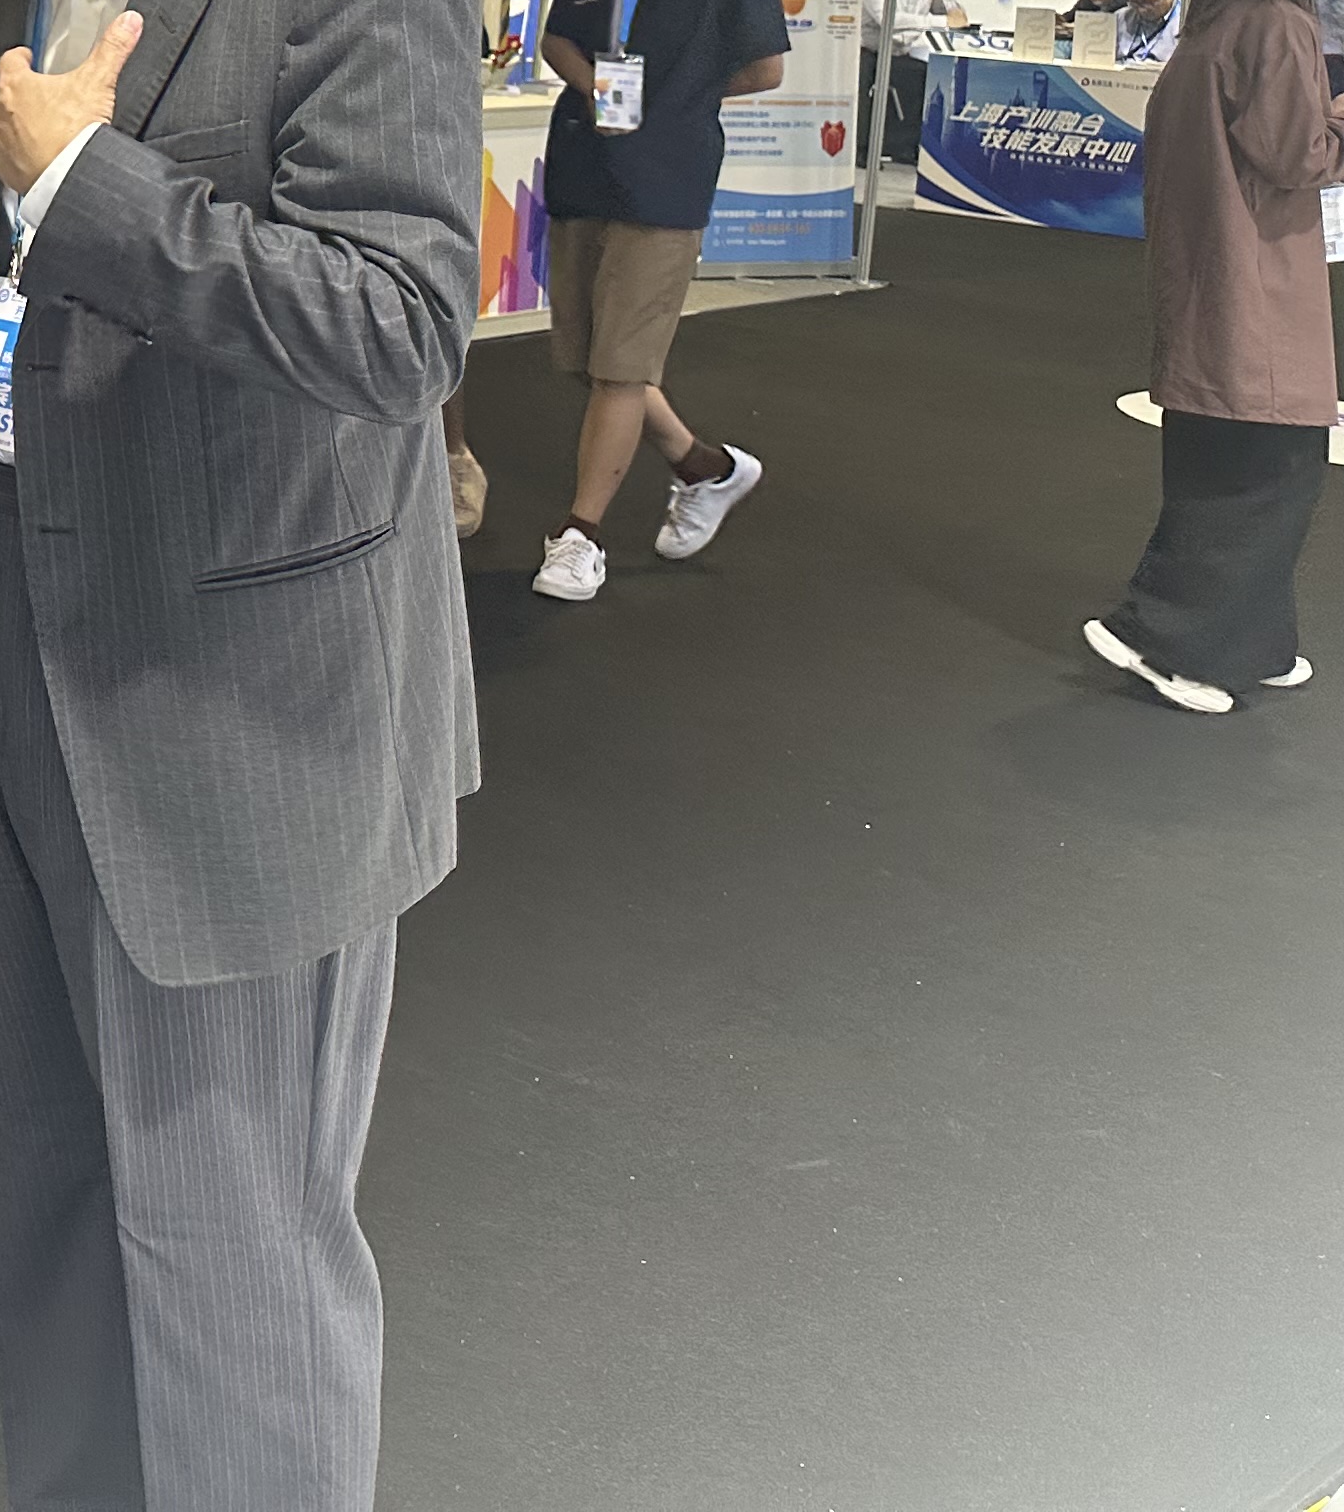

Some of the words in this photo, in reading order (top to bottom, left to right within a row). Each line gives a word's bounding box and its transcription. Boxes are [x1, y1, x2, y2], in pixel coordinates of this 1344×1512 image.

[979, 125, 1137, 164] 技能发展中心
